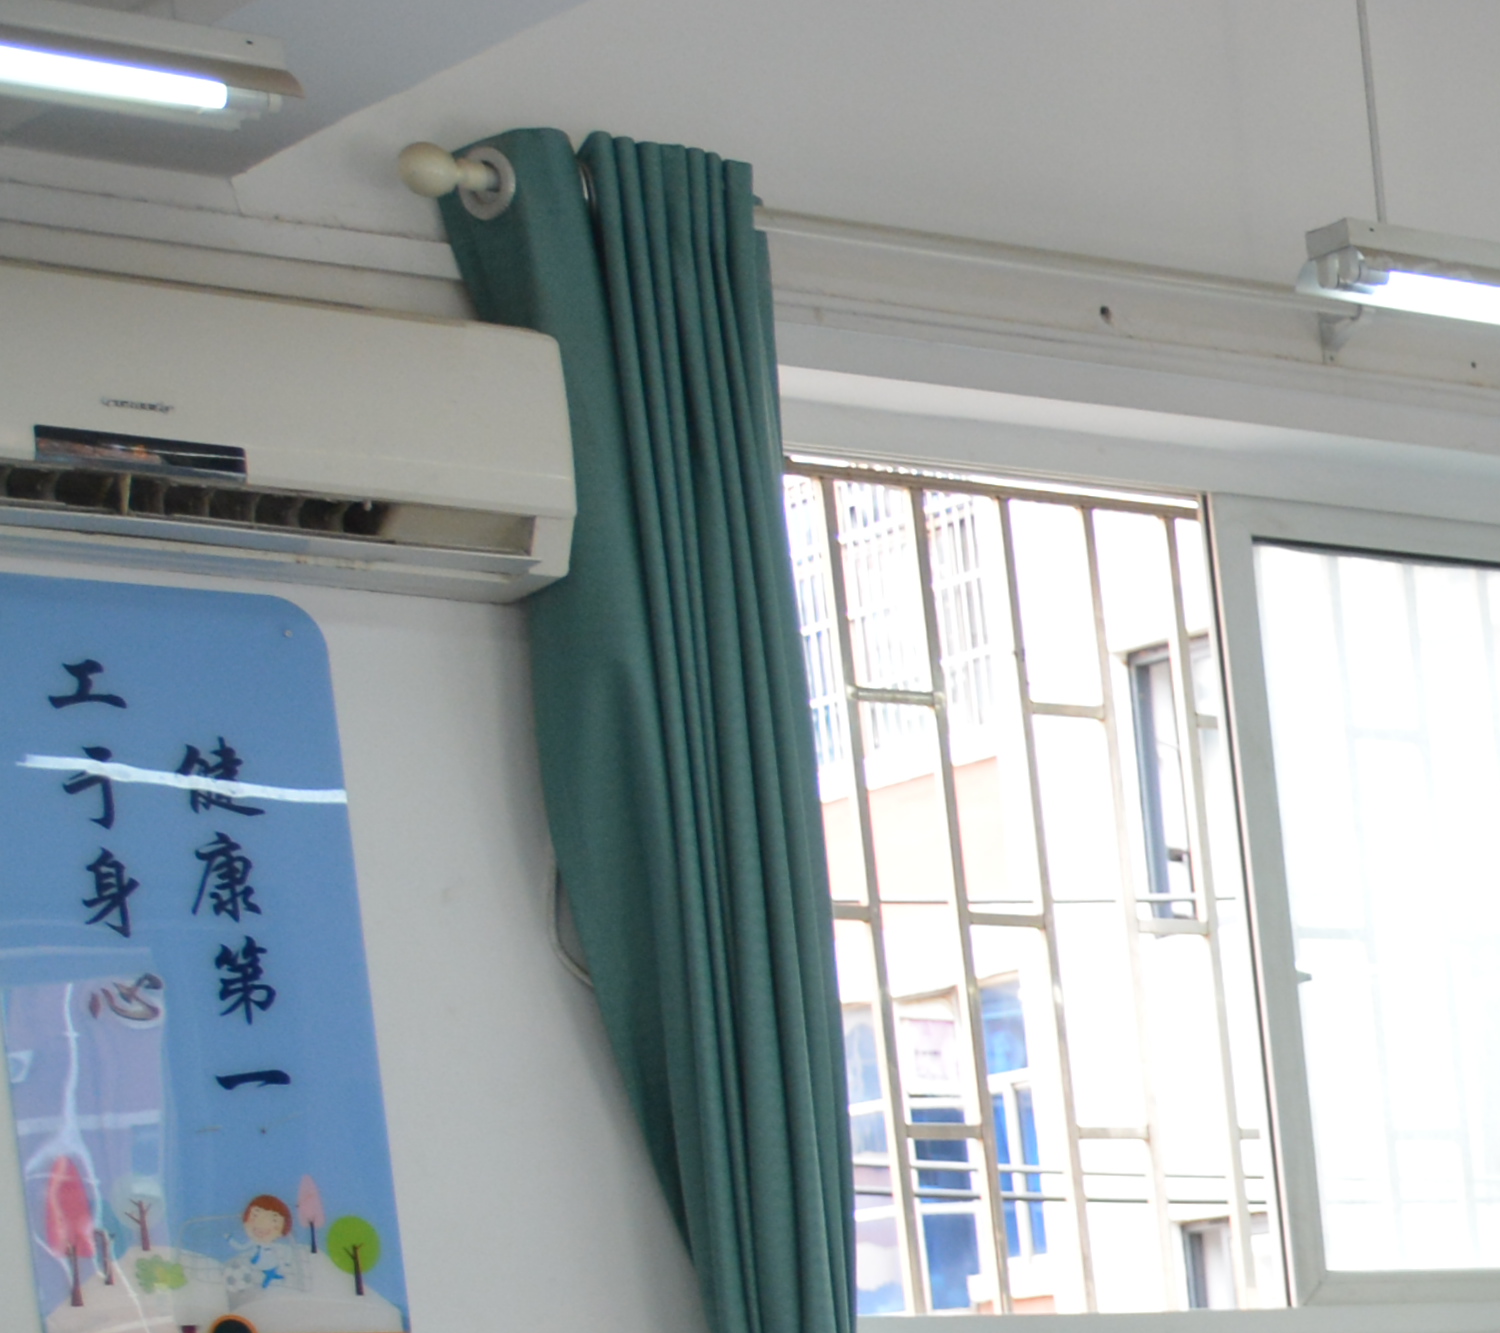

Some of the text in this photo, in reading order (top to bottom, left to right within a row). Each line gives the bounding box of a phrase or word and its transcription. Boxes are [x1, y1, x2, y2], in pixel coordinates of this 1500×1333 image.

[47, 658, 166, 1026] 工于身心
[173, 734, 292, 1092] 健康第一
